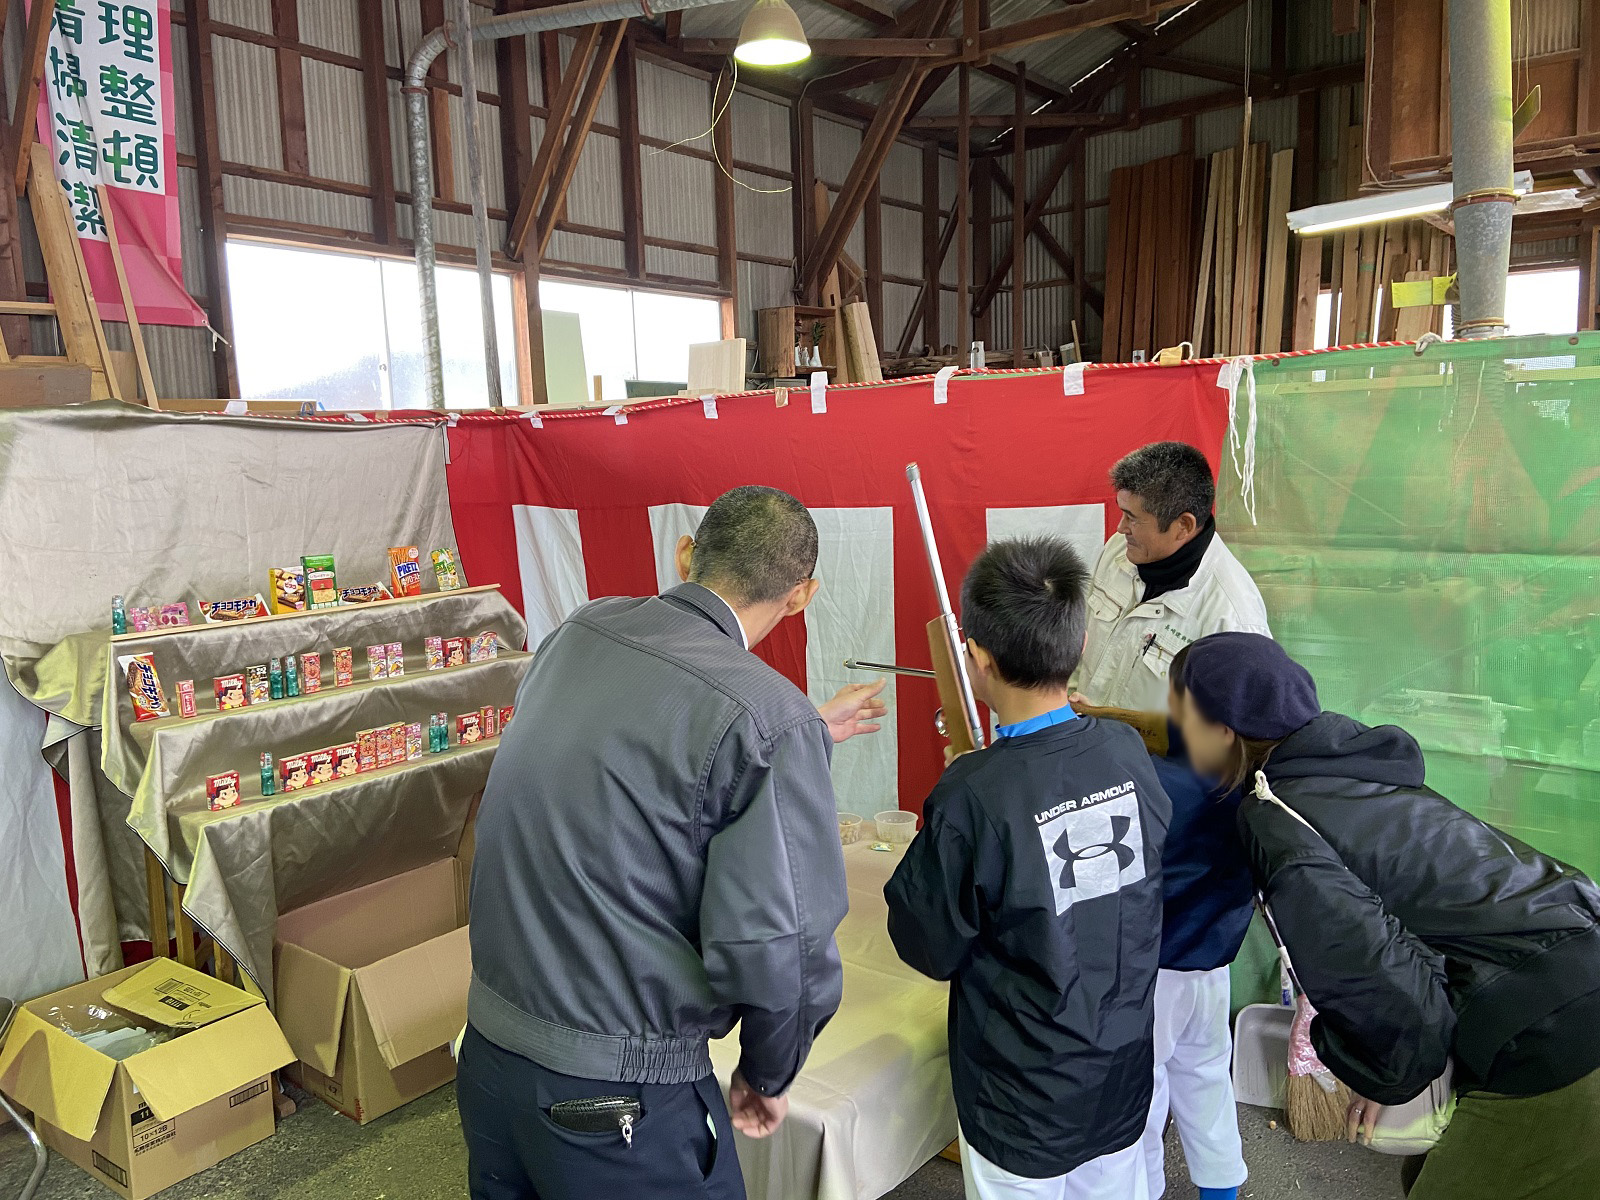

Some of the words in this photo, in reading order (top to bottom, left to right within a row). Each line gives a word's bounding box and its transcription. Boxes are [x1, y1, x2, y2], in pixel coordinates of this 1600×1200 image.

[396, 562, 419, 577] PRETZ
[210, 600, 257, 616] チョコモナカ
[220, 678, 243, 688] Milky
[461, 715, 480, 727] Milky
[336, 746, 358, 757] Milky
[286, 758, 308, 770] Milky
[311, 753, 333, 764] Milky
[213, 776, 237, 789] Milky
[1034, 800, 1077, 824] UNDER
[1081, 780, 1135, 807] ARMOUR
